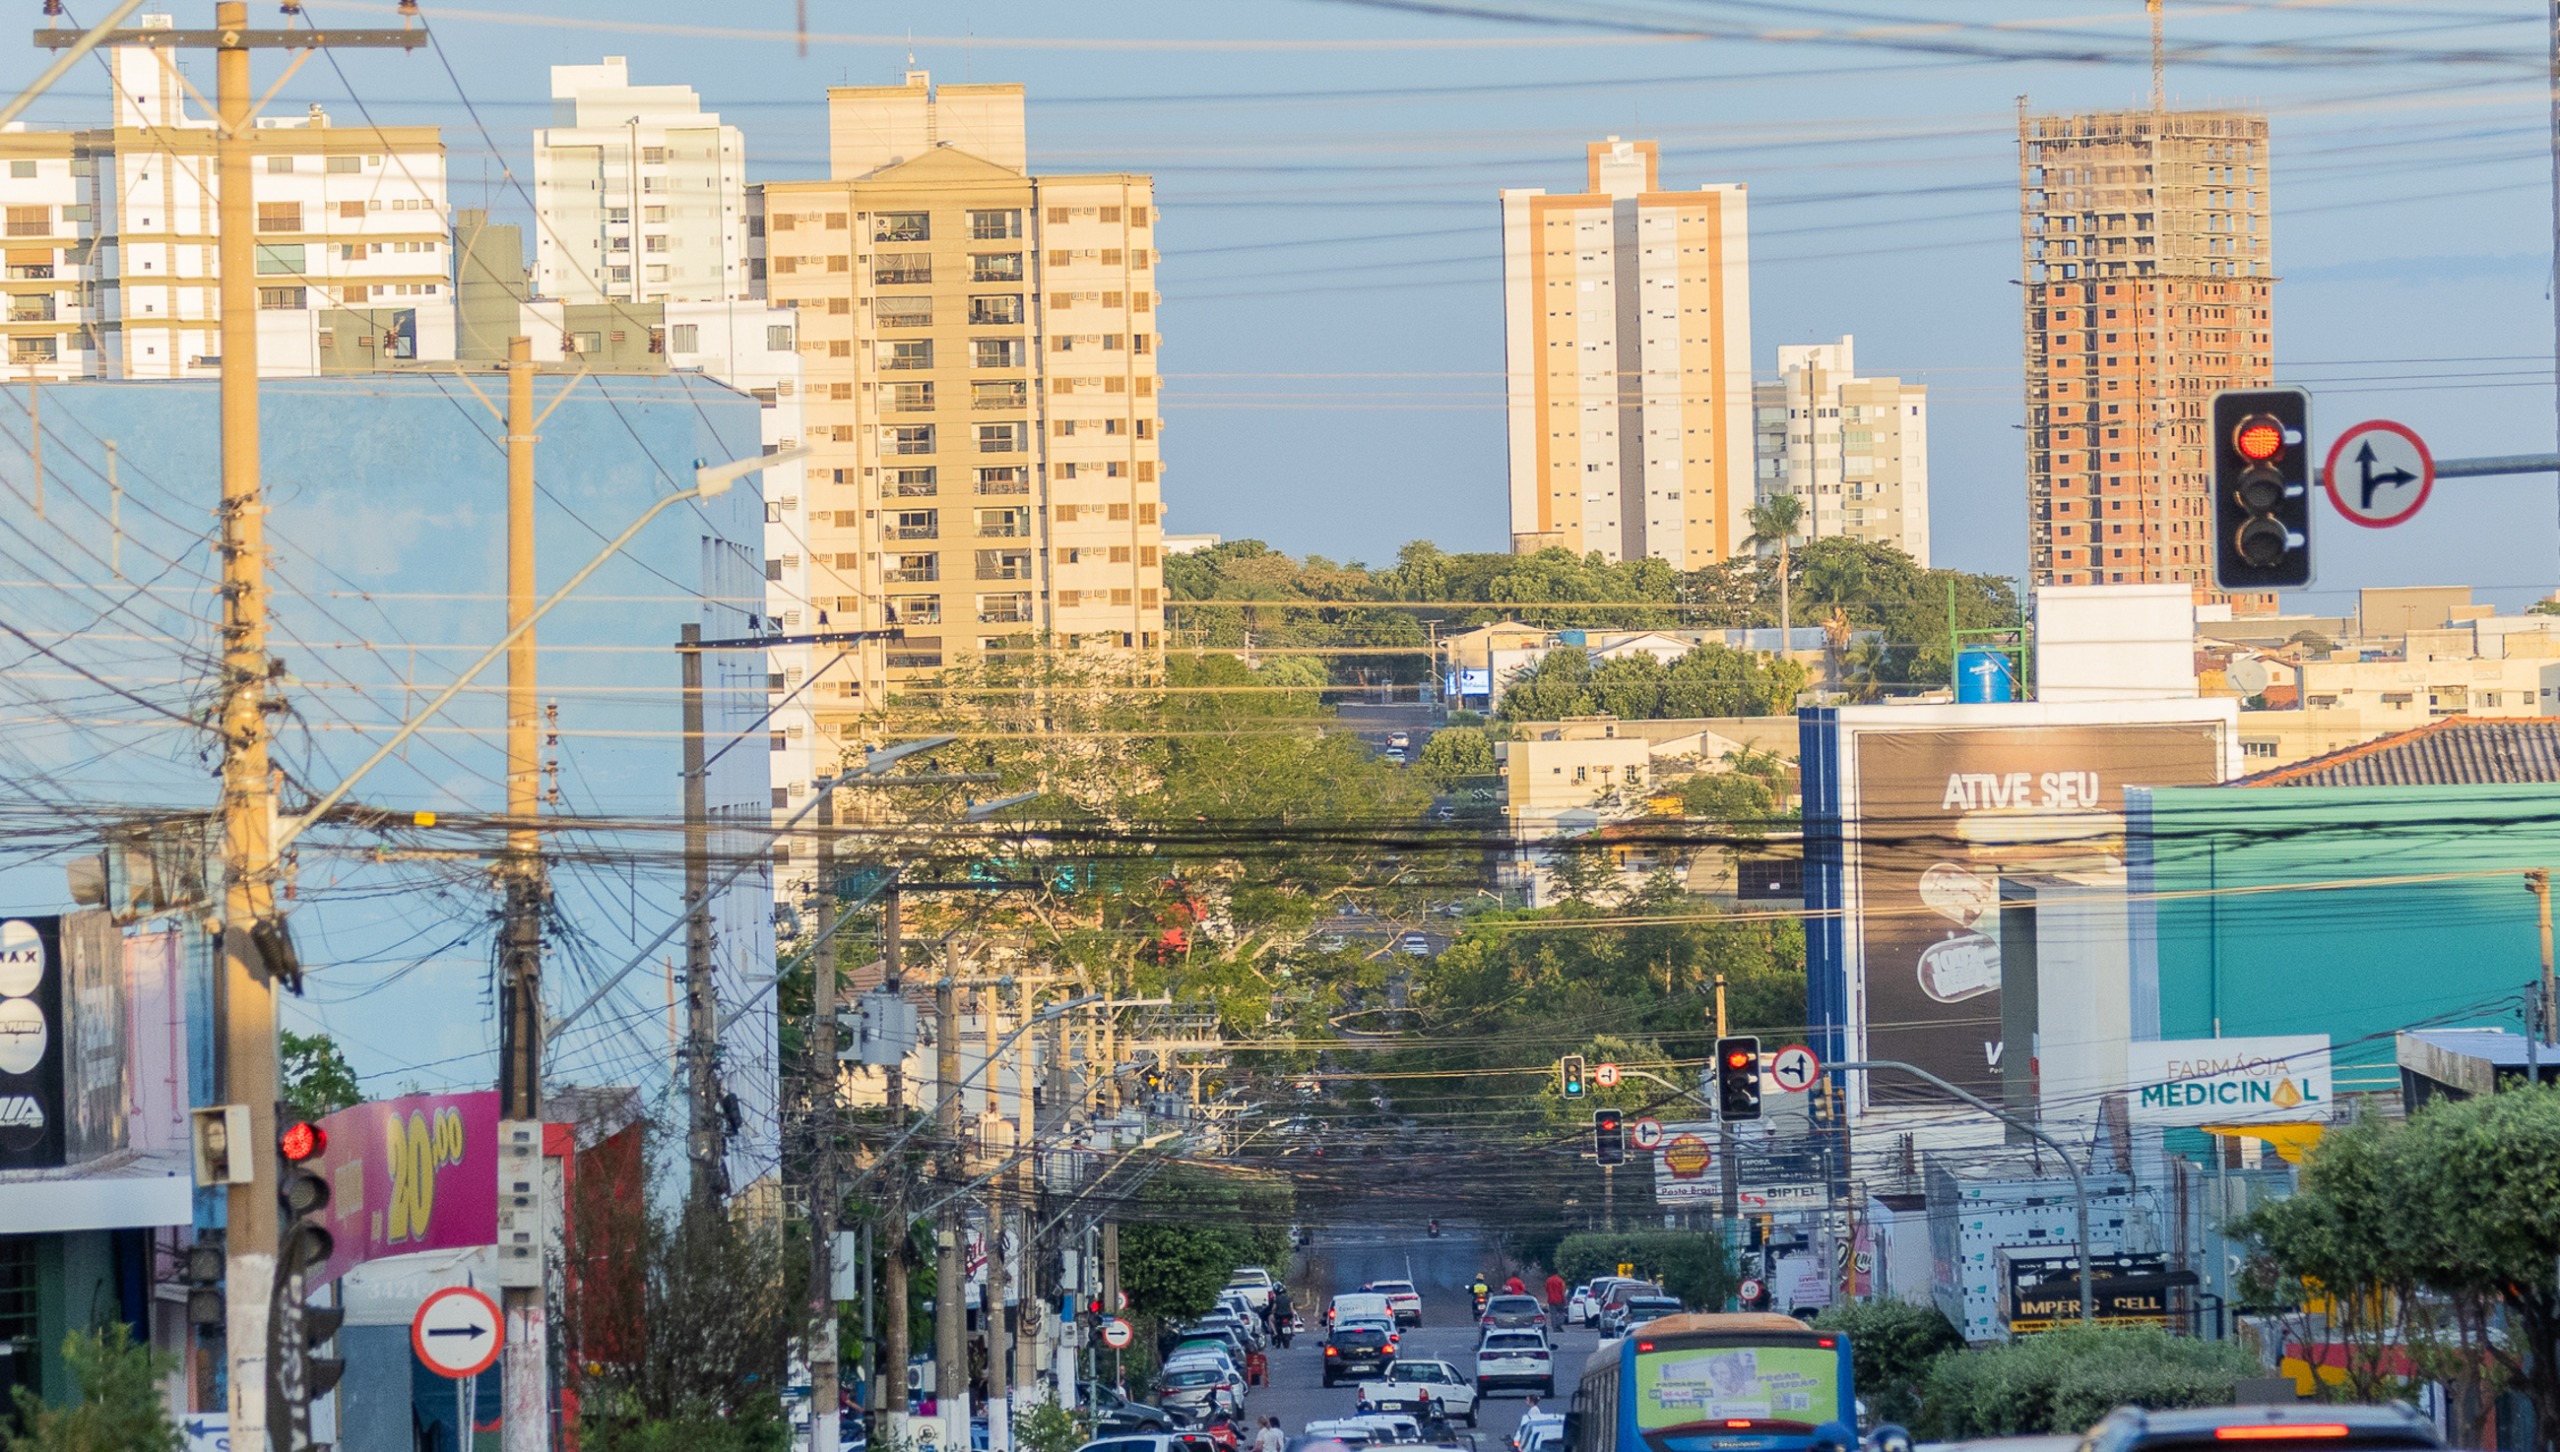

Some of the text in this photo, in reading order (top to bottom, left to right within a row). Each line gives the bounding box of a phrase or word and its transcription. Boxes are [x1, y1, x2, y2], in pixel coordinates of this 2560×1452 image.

[1942, 771, 2099, 810] ATIVE SEU
[2167, 1052, 2291, 1079] FARMÁCIA
[1661, 1185, 1718, 1196] Posto Brasil
[1744, 1284, 1757, 1295] 40
[2114, 1296, 2161, 1310] CELL
